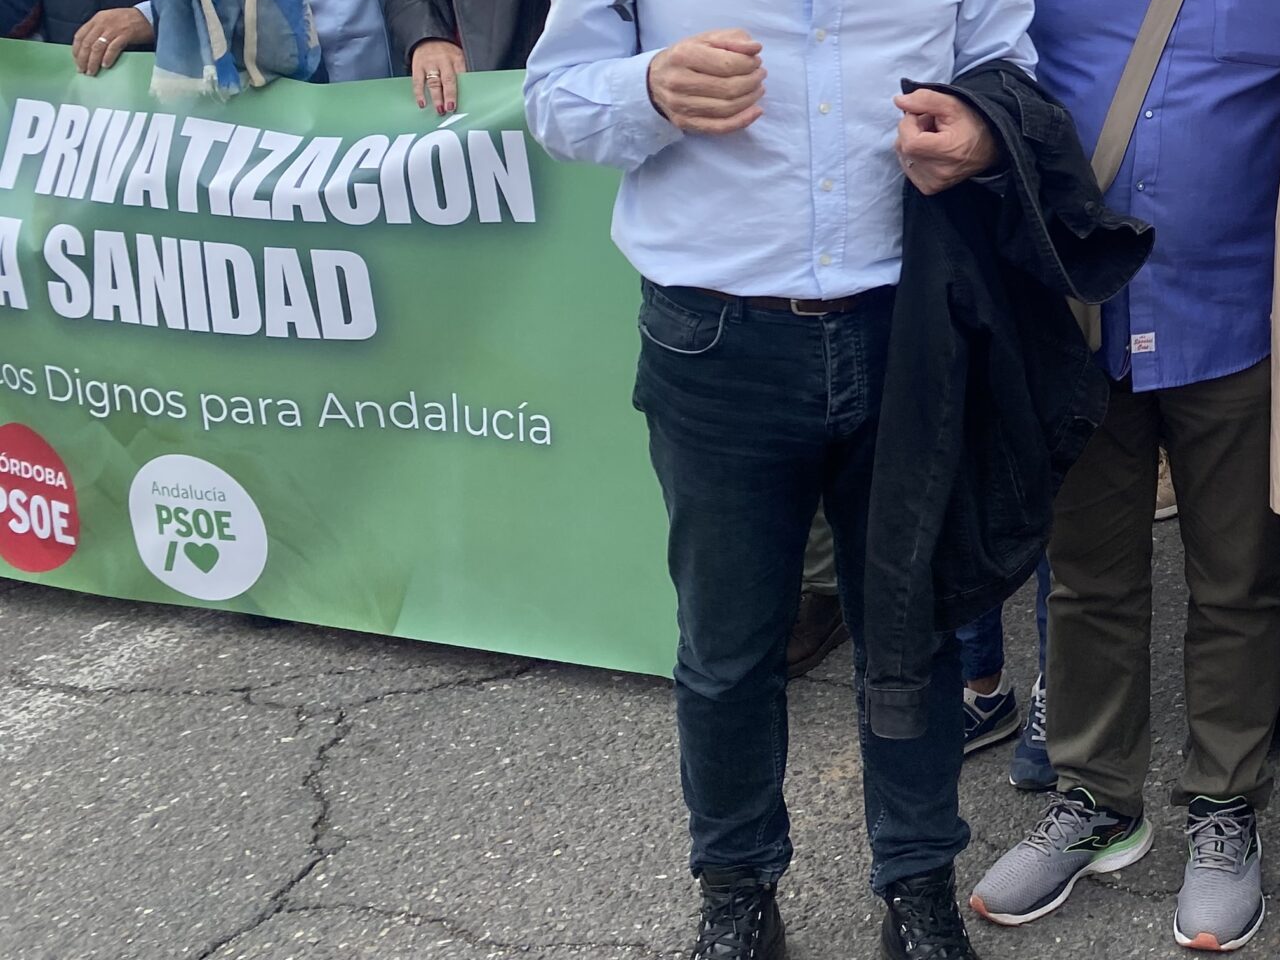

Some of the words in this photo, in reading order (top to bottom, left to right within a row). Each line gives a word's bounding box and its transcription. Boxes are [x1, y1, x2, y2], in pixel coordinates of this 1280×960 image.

[0, 98, 536, 226] PRIVATIZACIÓN
[44, 223, 377, 340] SANIDAD
[0, 364, 37, 395] os
[45, 365, 187, 419] Dignos
[200, 393, 301, 430] para
[318, 391, 551, 445] Andalucía
[151, 481, 226, 502] Andalucía
[155, 504, 237, 542] PSOE
